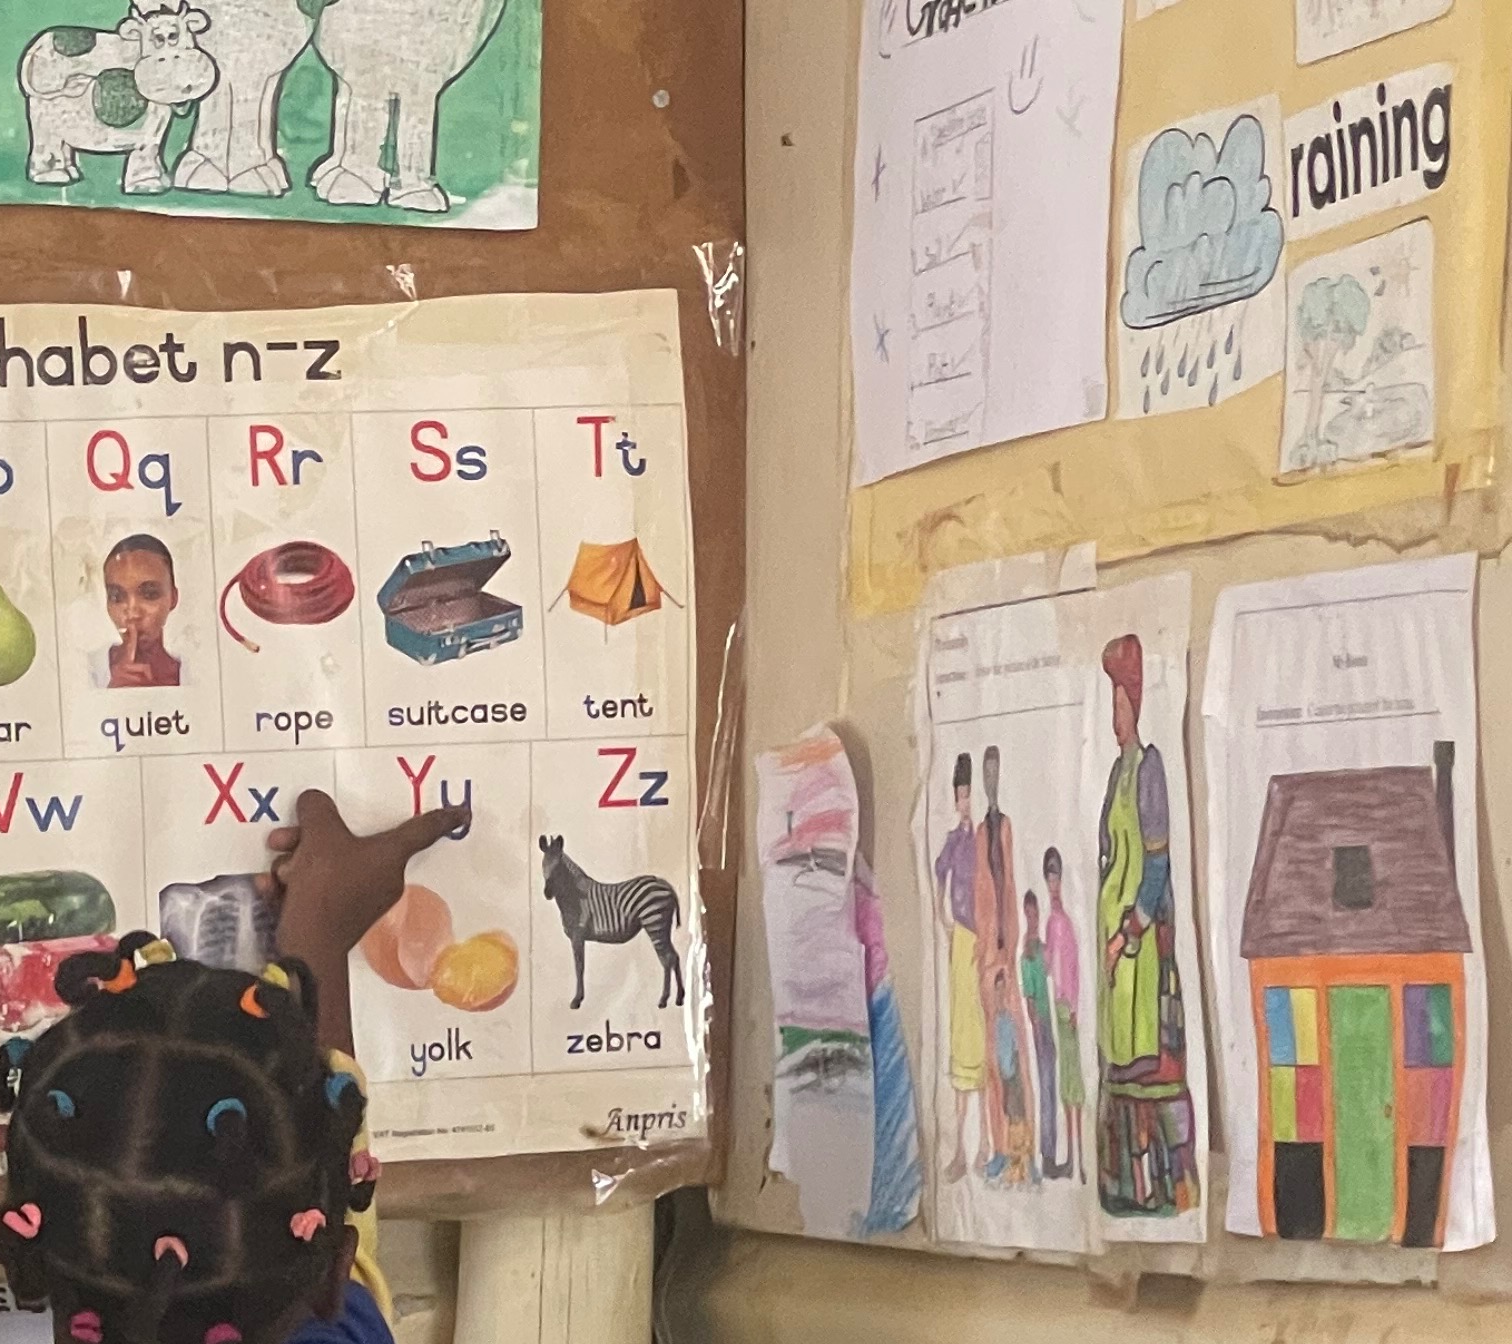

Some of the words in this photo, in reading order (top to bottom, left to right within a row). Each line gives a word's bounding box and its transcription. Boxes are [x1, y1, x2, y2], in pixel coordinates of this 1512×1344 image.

[1290, 83, 1452, 218] raining
[223, 339, 342, 383] n-z
[249, 424, 324, 487] Rr
[410, 420, 488, 483] Ss
[576, 415, 647, 478] Tt
[86, 429, 183, 517] Qq
[255, 710, 334, 746] rope
[388, 700, 527, 727] suitcase
[583, 692, 654, 719] tent
[100, 709, 190, 753] quiet
[203, 762, 280, 825] Xx
[597, 747, 670, 809] Zz
[410, 1027, 473, 1077] yolk
[566, 1019, 661, 1054] zebra
[606, 1103, 687, 1139] Anpris
